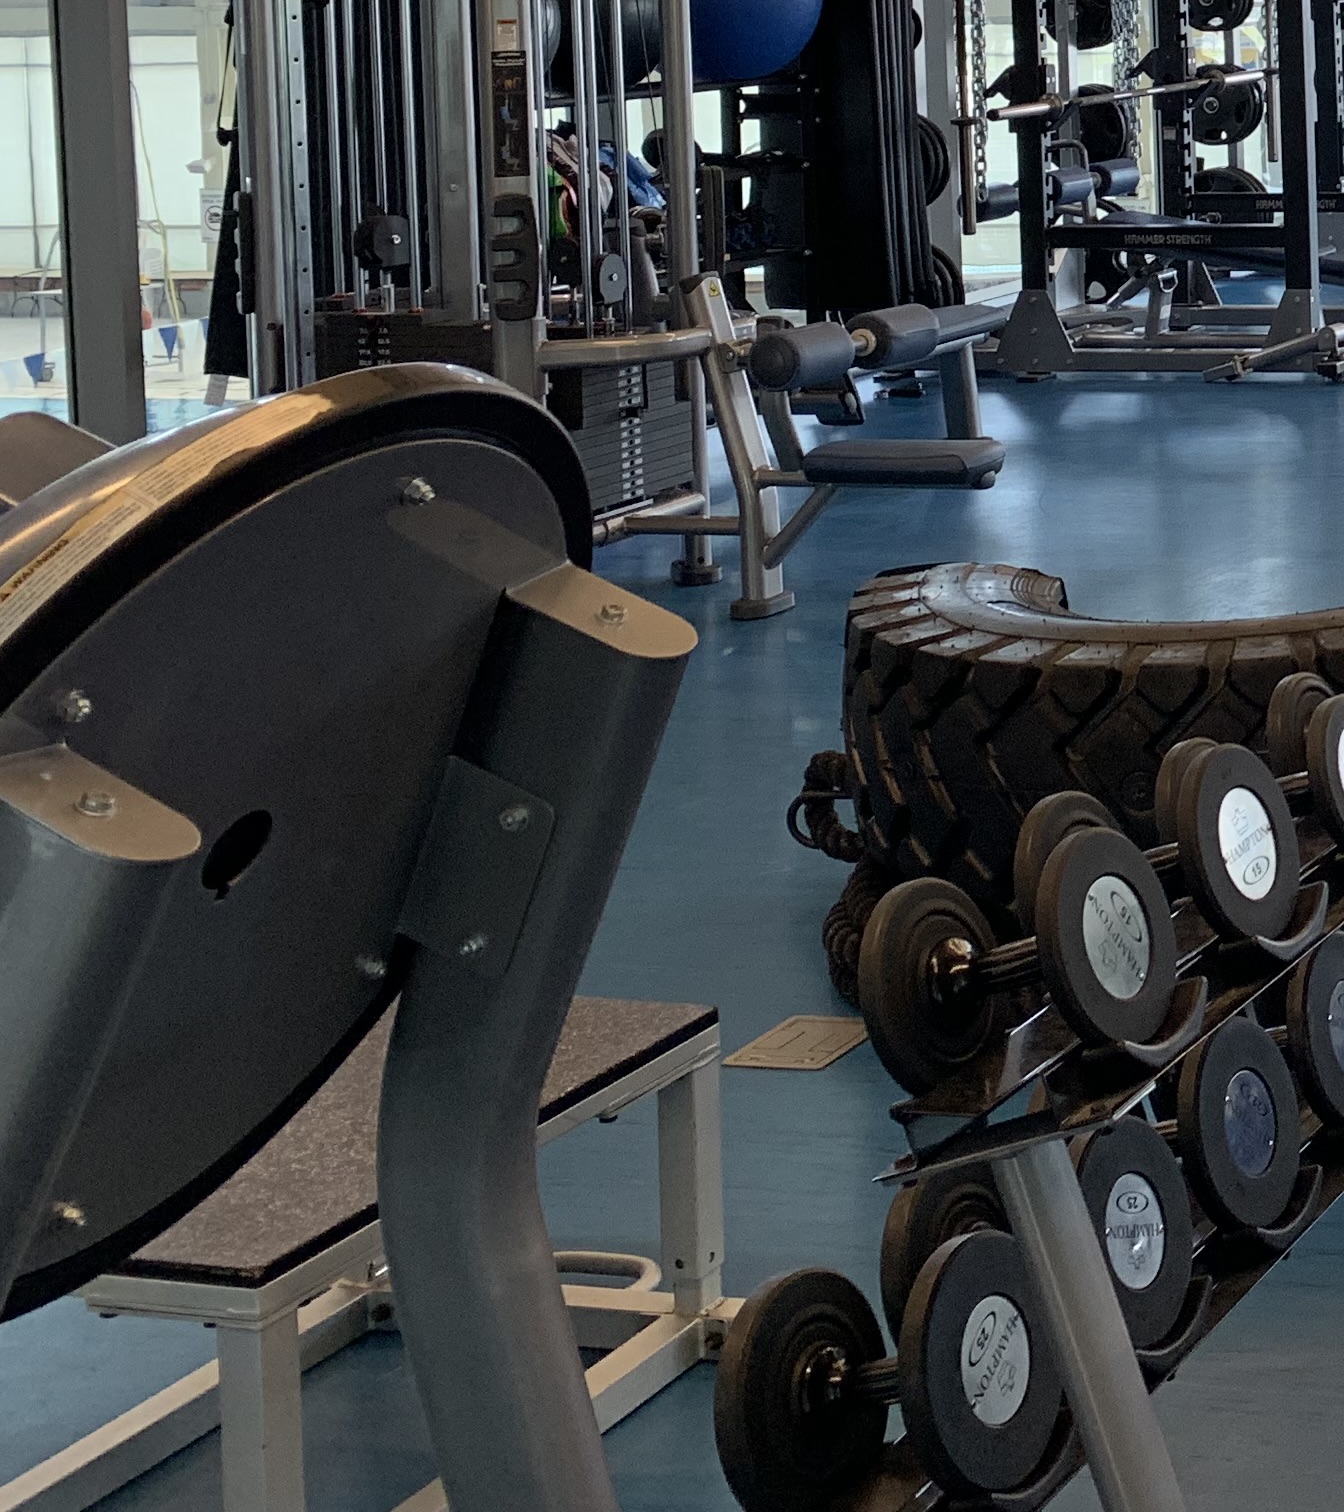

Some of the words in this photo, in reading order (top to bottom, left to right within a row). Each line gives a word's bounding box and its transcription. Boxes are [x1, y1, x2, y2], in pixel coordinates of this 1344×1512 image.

[1227, 824, 1271, 865] HAMPTON
[1251, 862, 1263, 879] 15
[1093, 896, 1141, 978] HAMPTON
[1127, 1196, 1138, 1209] 25
[1107, 1223, 1161, 1239] HAMPTON
[976, 1327, 989, 1350] 25
[974, 1316, 1016, 1405] HAMPTON
